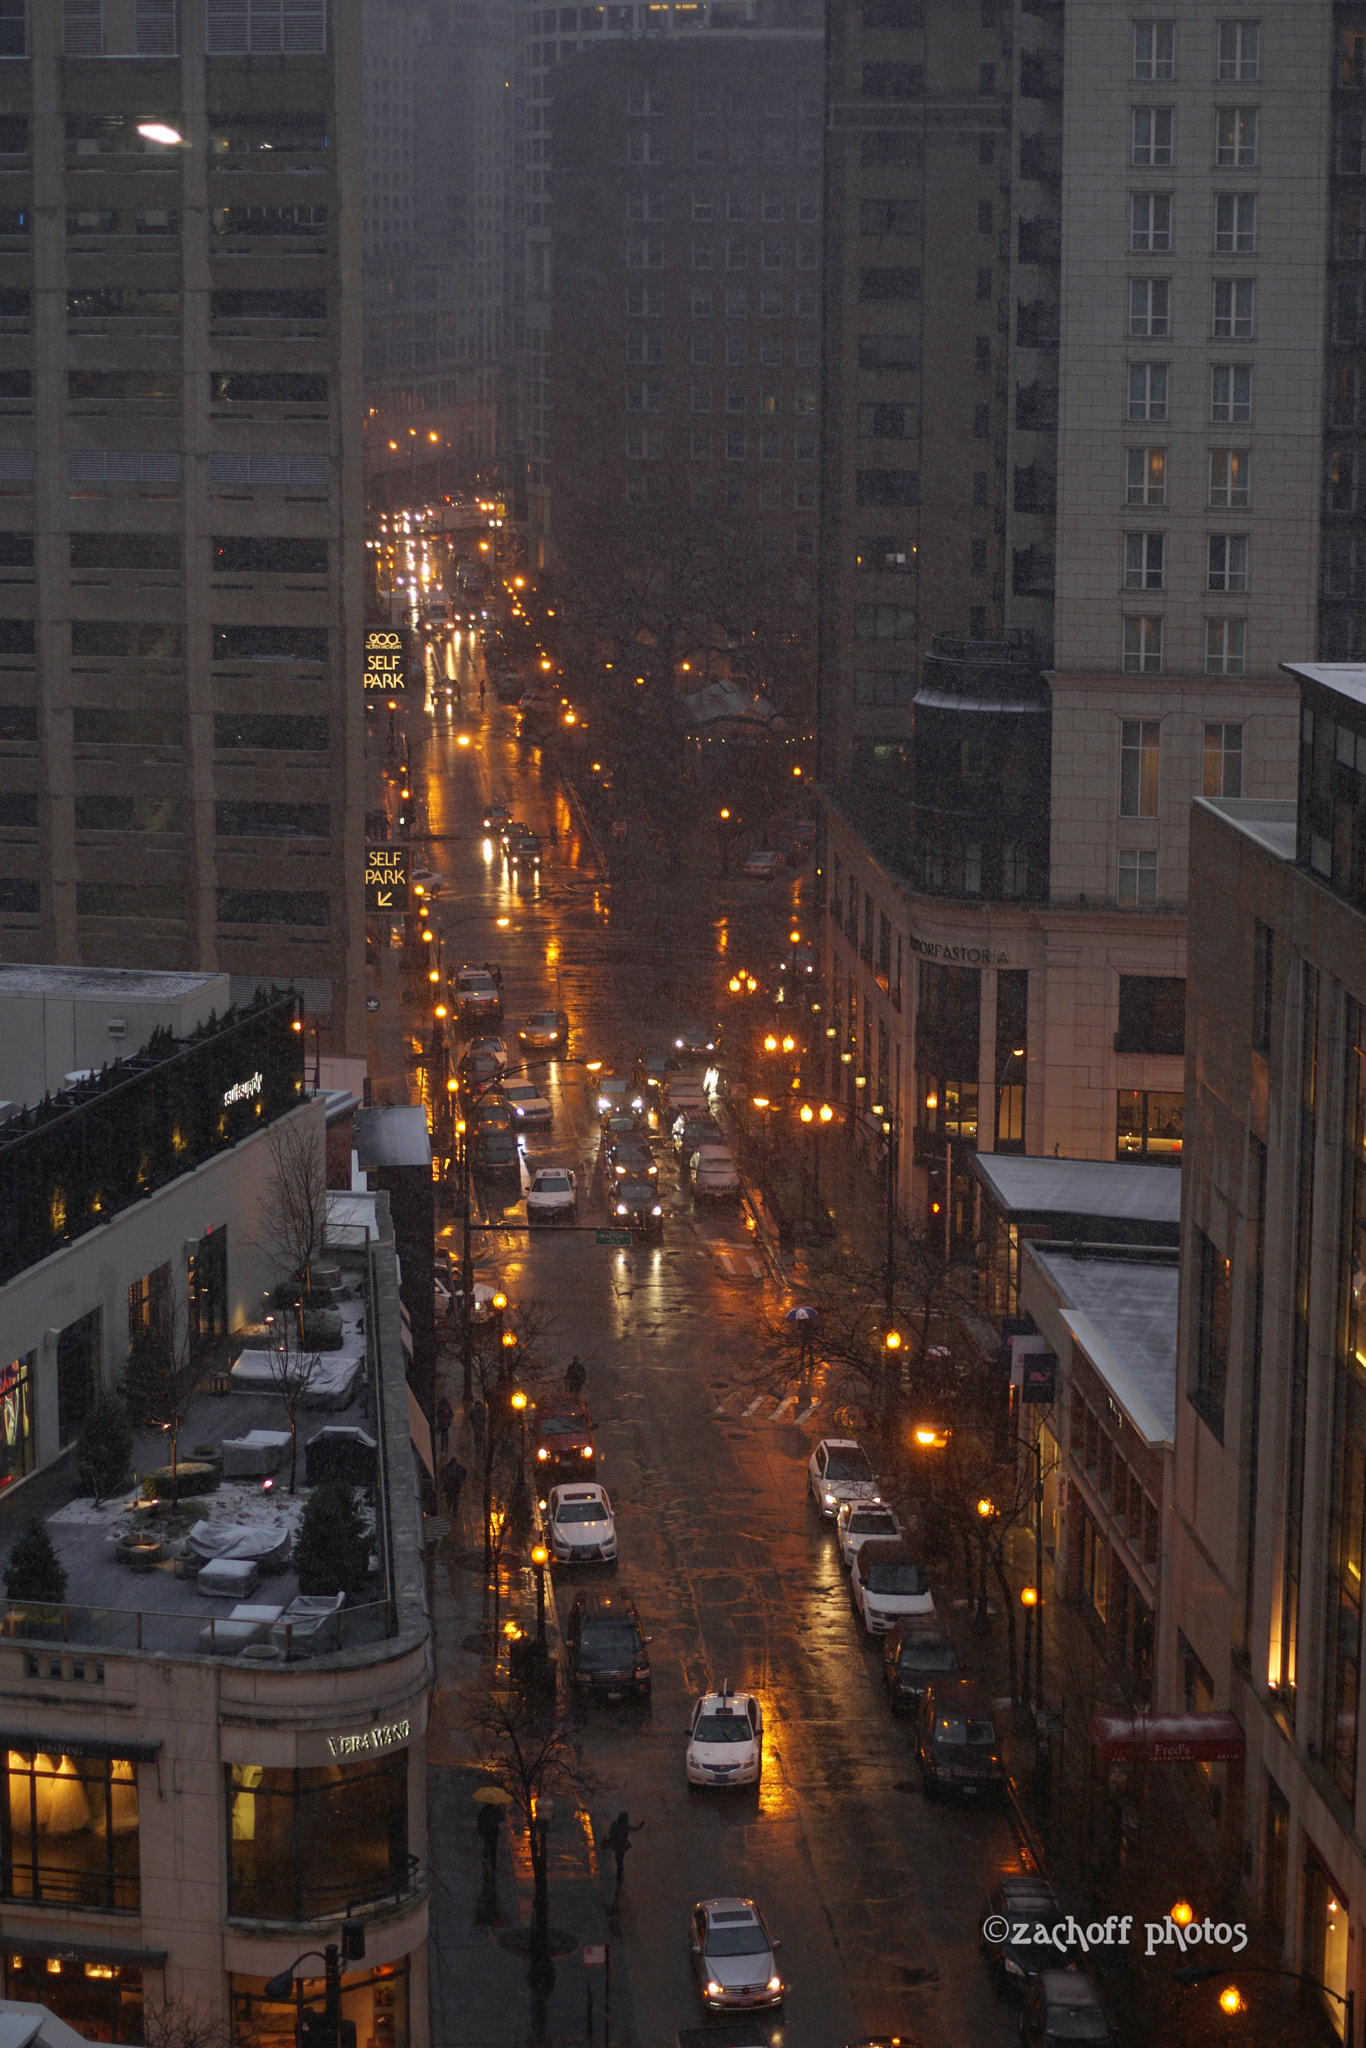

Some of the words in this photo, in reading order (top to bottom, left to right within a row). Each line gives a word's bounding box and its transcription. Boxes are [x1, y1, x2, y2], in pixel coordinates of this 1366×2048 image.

[369, 633, 399, 645] 900
[368, 655, 401, 670] SELF
[364, 673, 405, 689] PARK
[369, 851, 402, 866] SELF
[365, 869, 406, 885] PARK
[943, 946, 1009, 964] ASTORIA
[224, 1071, 263, 1107] suitsupply
[327, 1733, 372, 1757] VERA
[371, 1719, 410, 1748] WANG
[1154, 1743, 1191, 1756] Fred's
